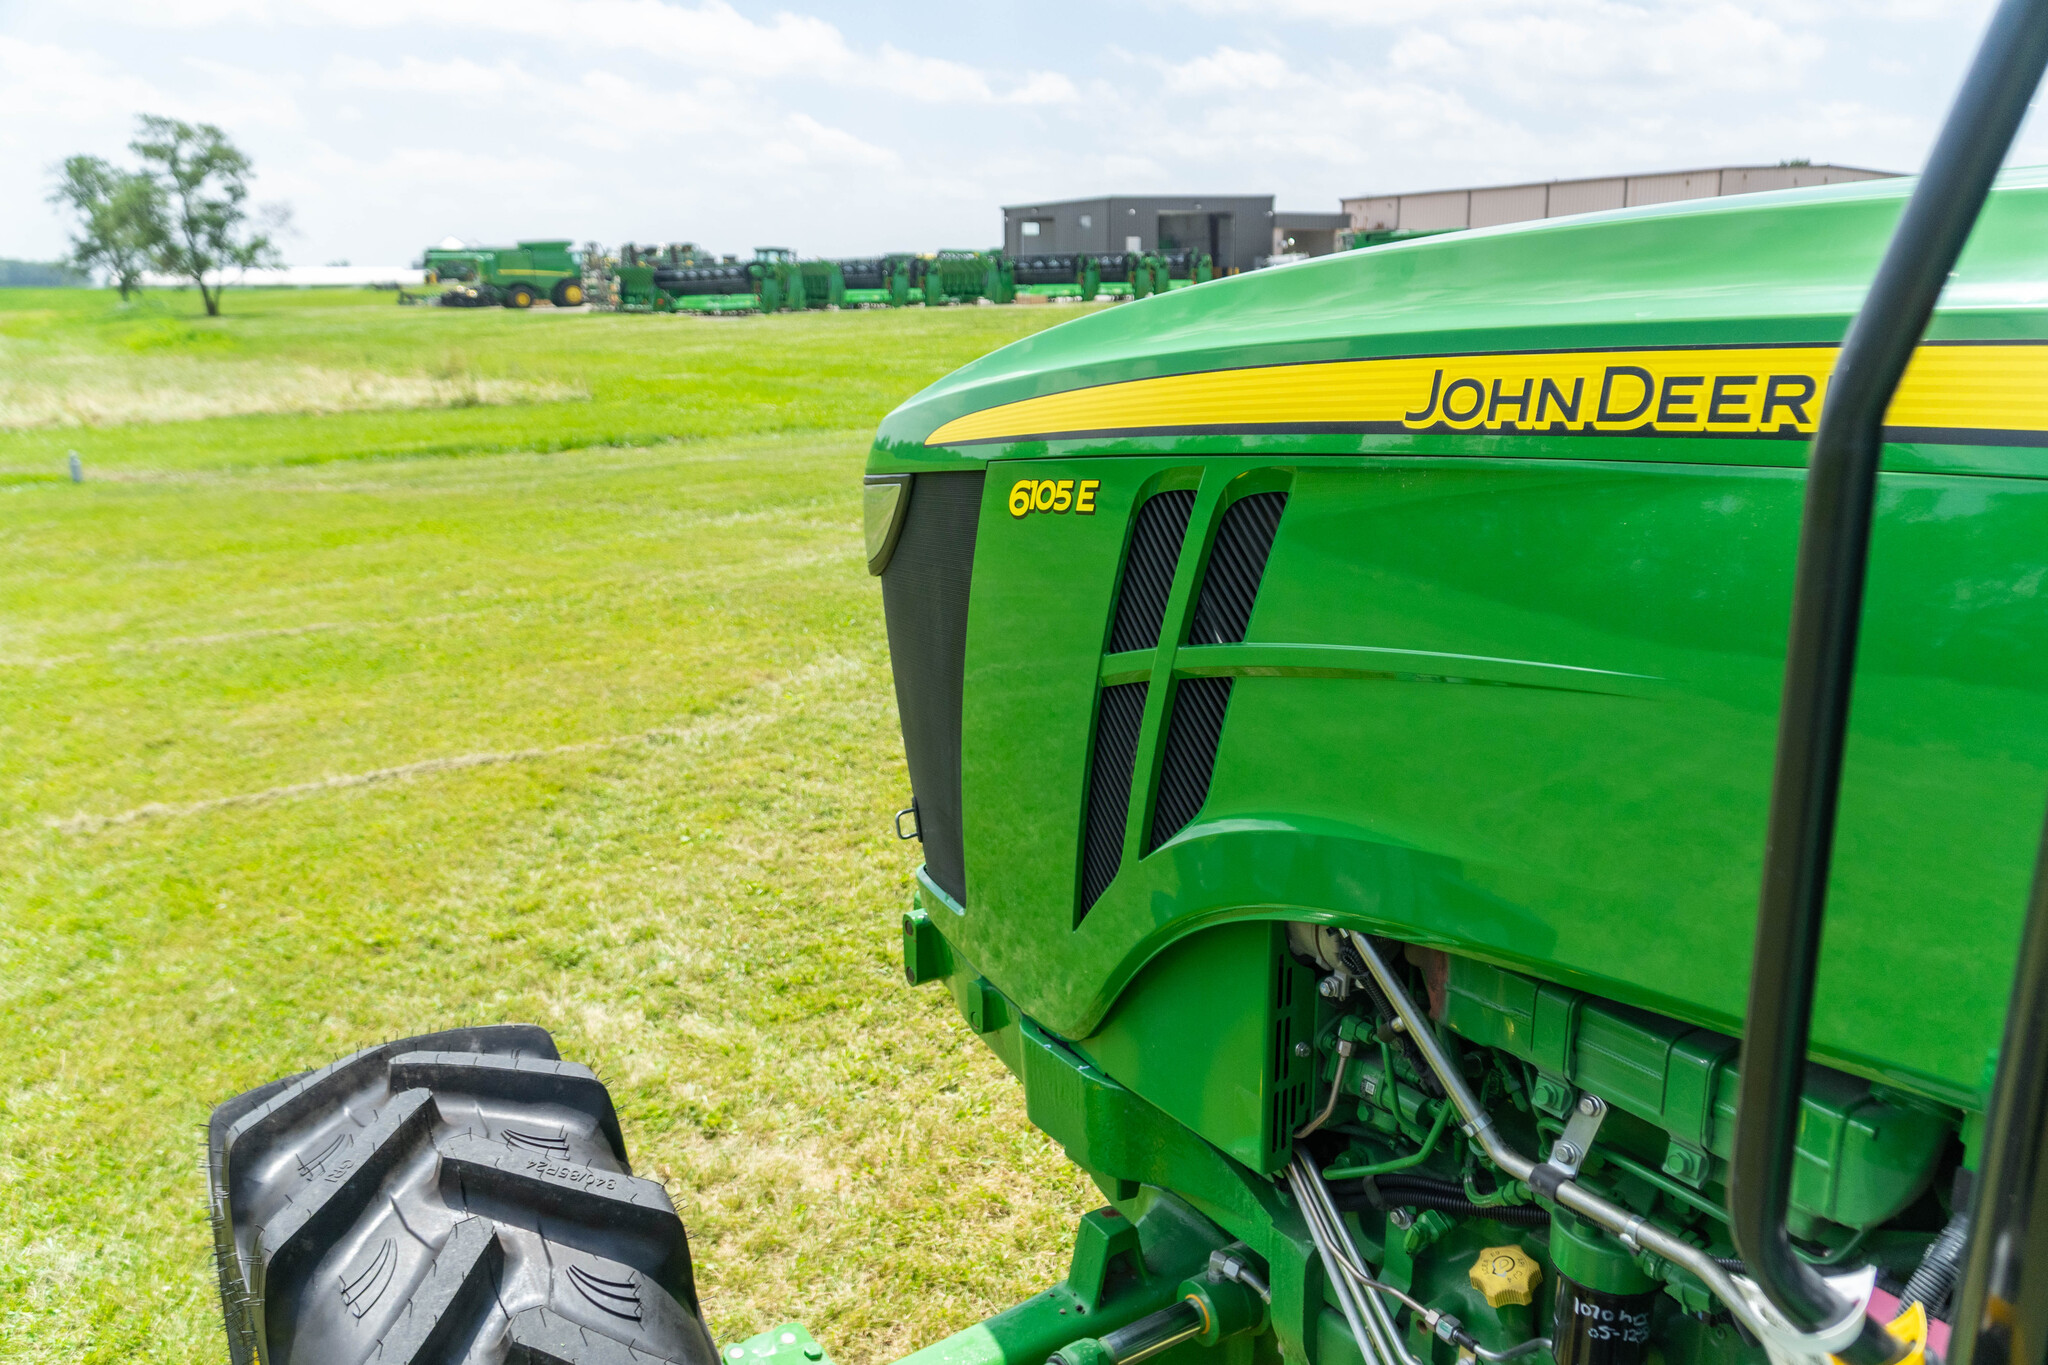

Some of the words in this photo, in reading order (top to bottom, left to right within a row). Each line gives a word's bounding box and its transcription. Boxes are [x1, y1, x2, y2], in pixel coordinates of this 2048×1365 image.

[1403, 369, 1586, 423] JOHN
[1595, 365, 1834, 424] DEER
[1008, 478, 1076, 521] 6105
[1074, 479, 1102, 516] E
[526, 1159, 617, 1191] 340/85R24
